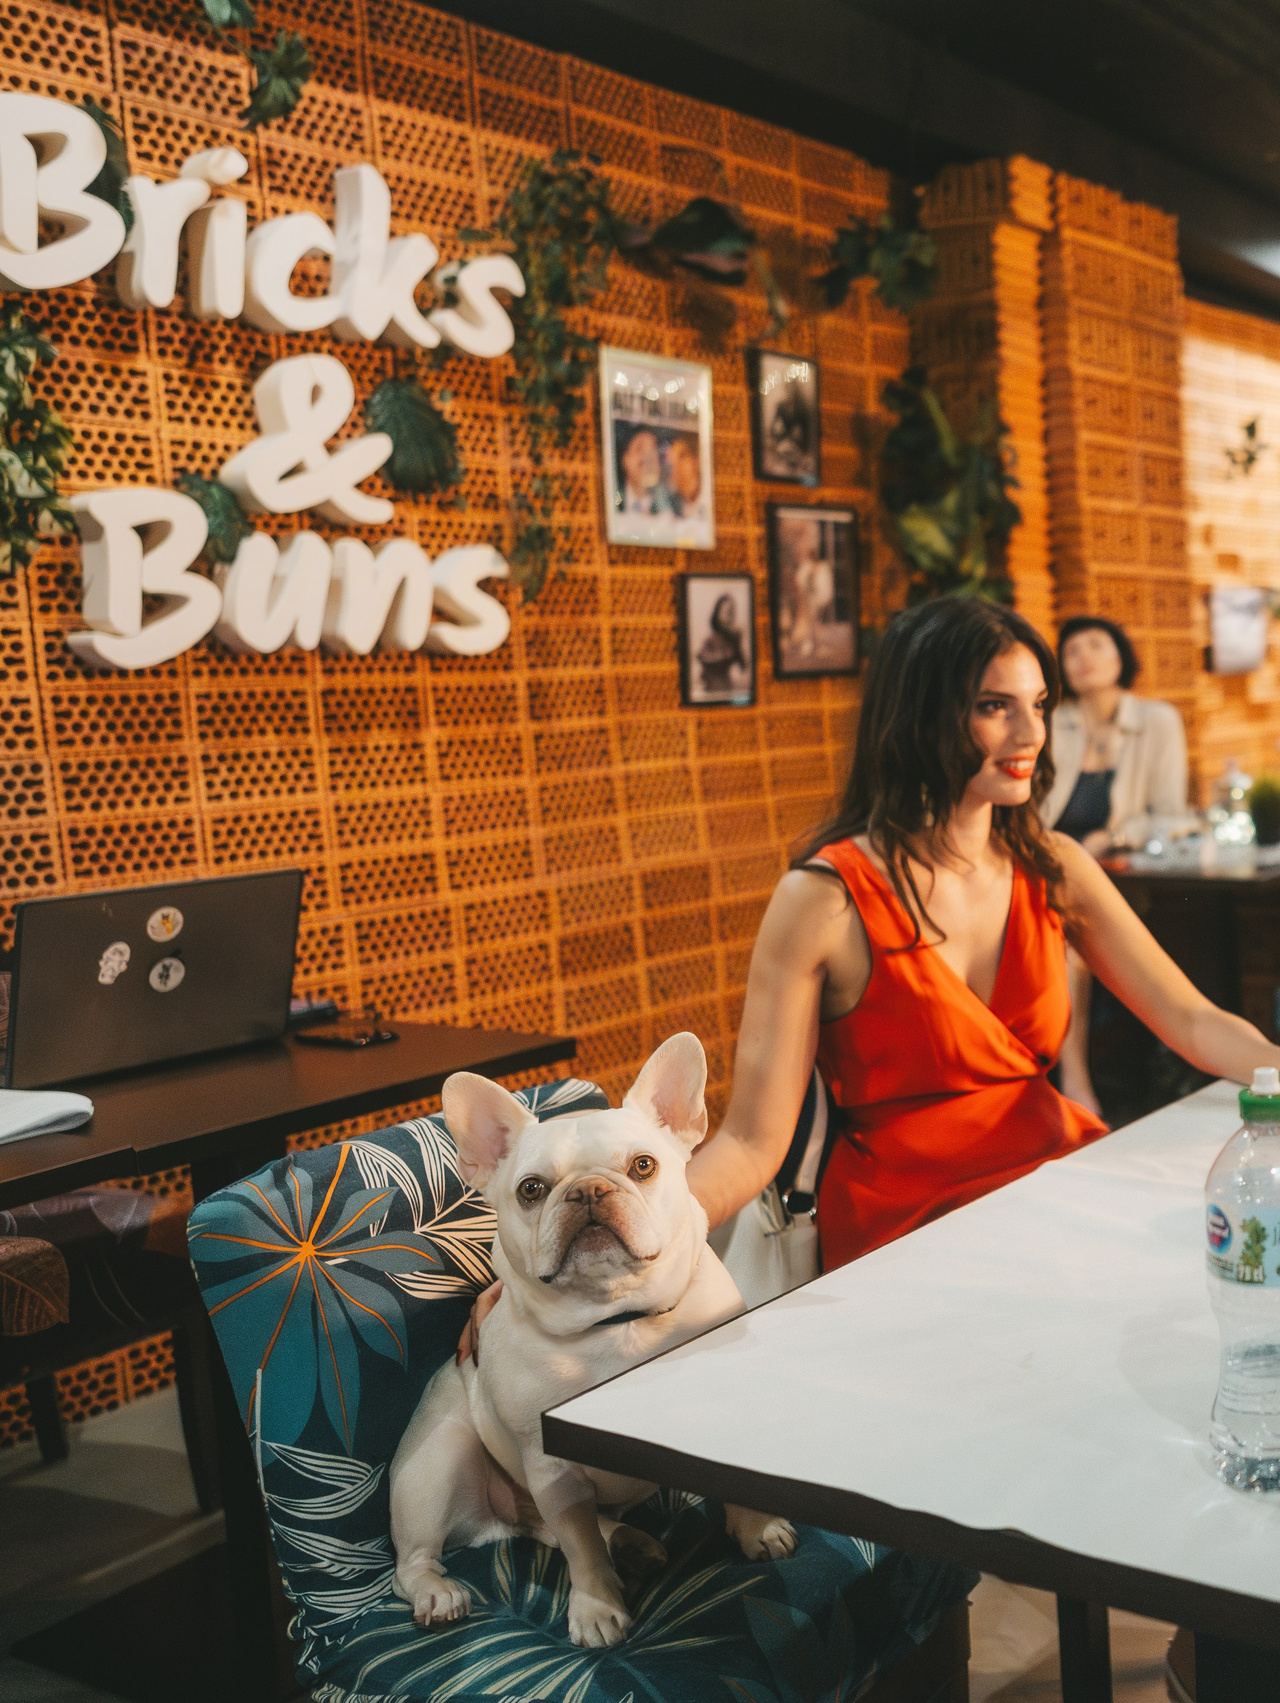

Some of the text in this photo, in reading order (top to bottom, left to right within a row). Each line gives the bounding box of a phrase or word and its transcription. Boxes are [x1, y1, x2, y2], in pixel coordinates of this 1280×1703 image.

[0, 92, 526, 358] Bricks
[220, 353, 395, 524] &
[68, 487, 510, 670] Buns
